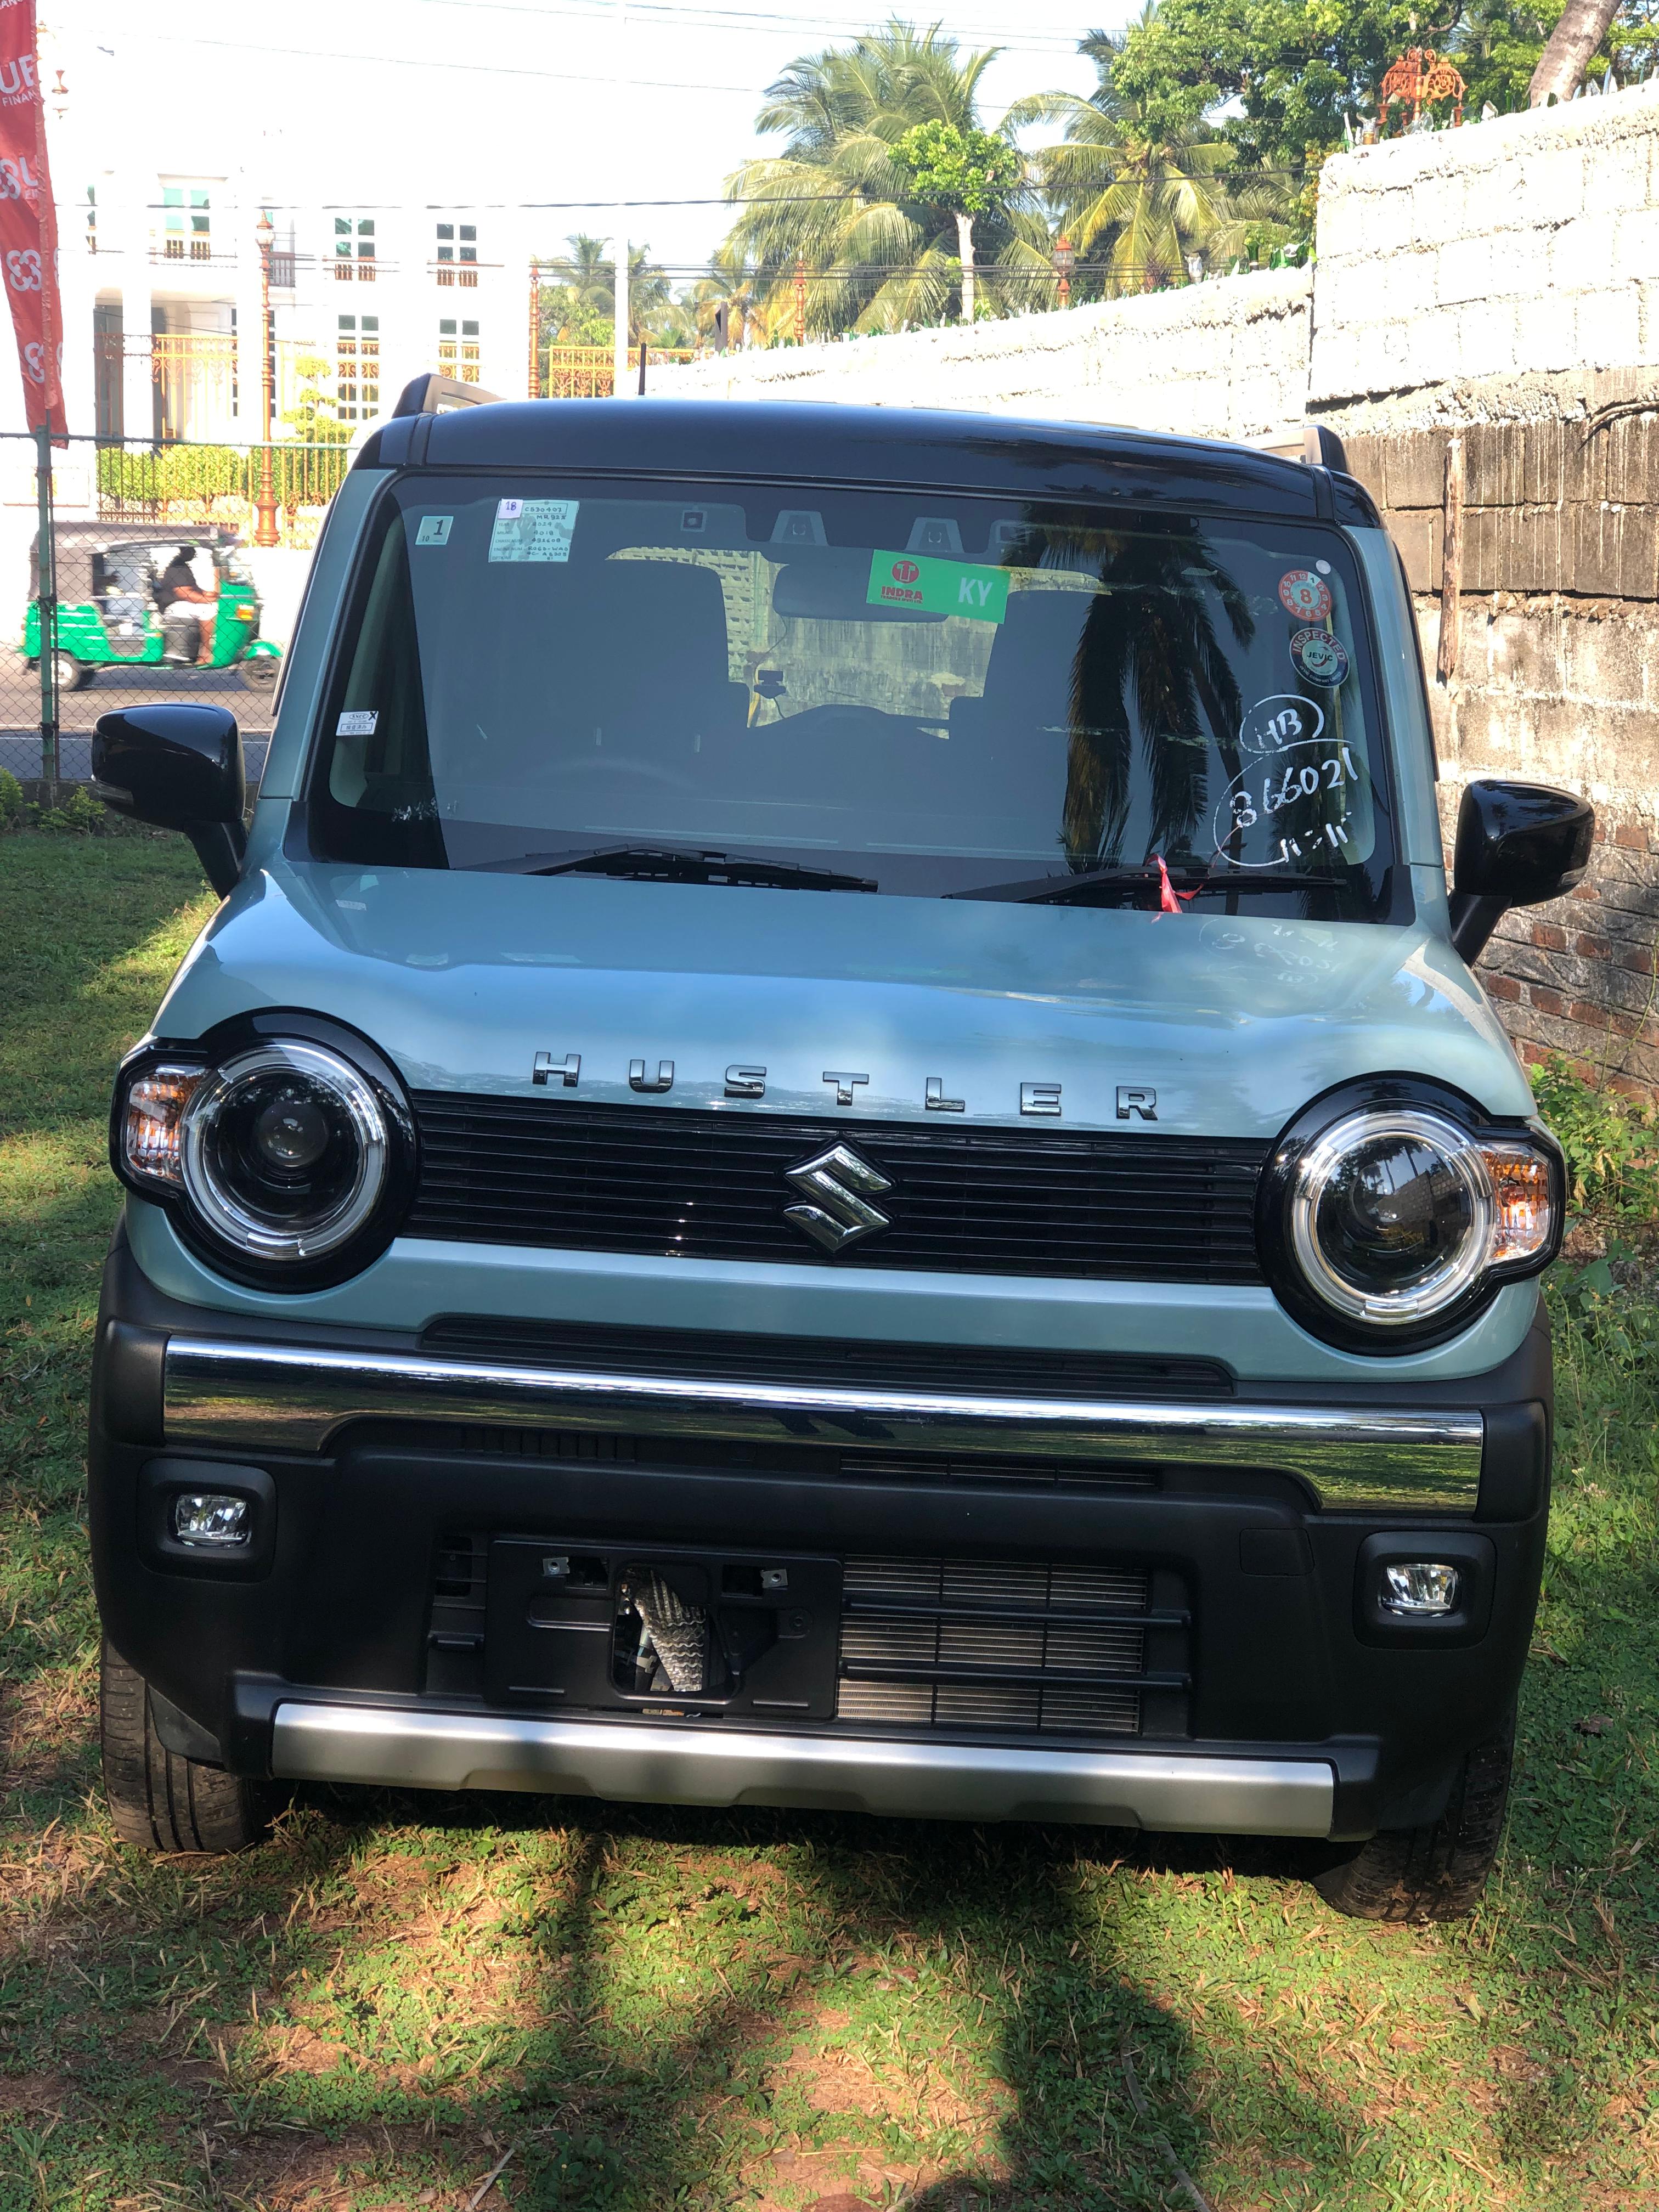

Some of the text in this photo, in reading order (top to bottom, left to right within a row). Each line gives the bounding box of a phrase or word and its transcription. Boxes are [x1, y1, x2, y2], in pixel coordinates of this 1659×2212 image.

[505, 501, 517, 511] 18
[433, 519, 444, 535] 1
[881, 585, 923, 600] INDRA
[958, 577, 994, 606] KY
[1300, 588, 1312, 604] 8
[1293, 630, 1346, 660] INSPECTED
[1307, 652, 1333, 662] JEVIC
[532, 1051, 1158, 1121] HUSTLER
